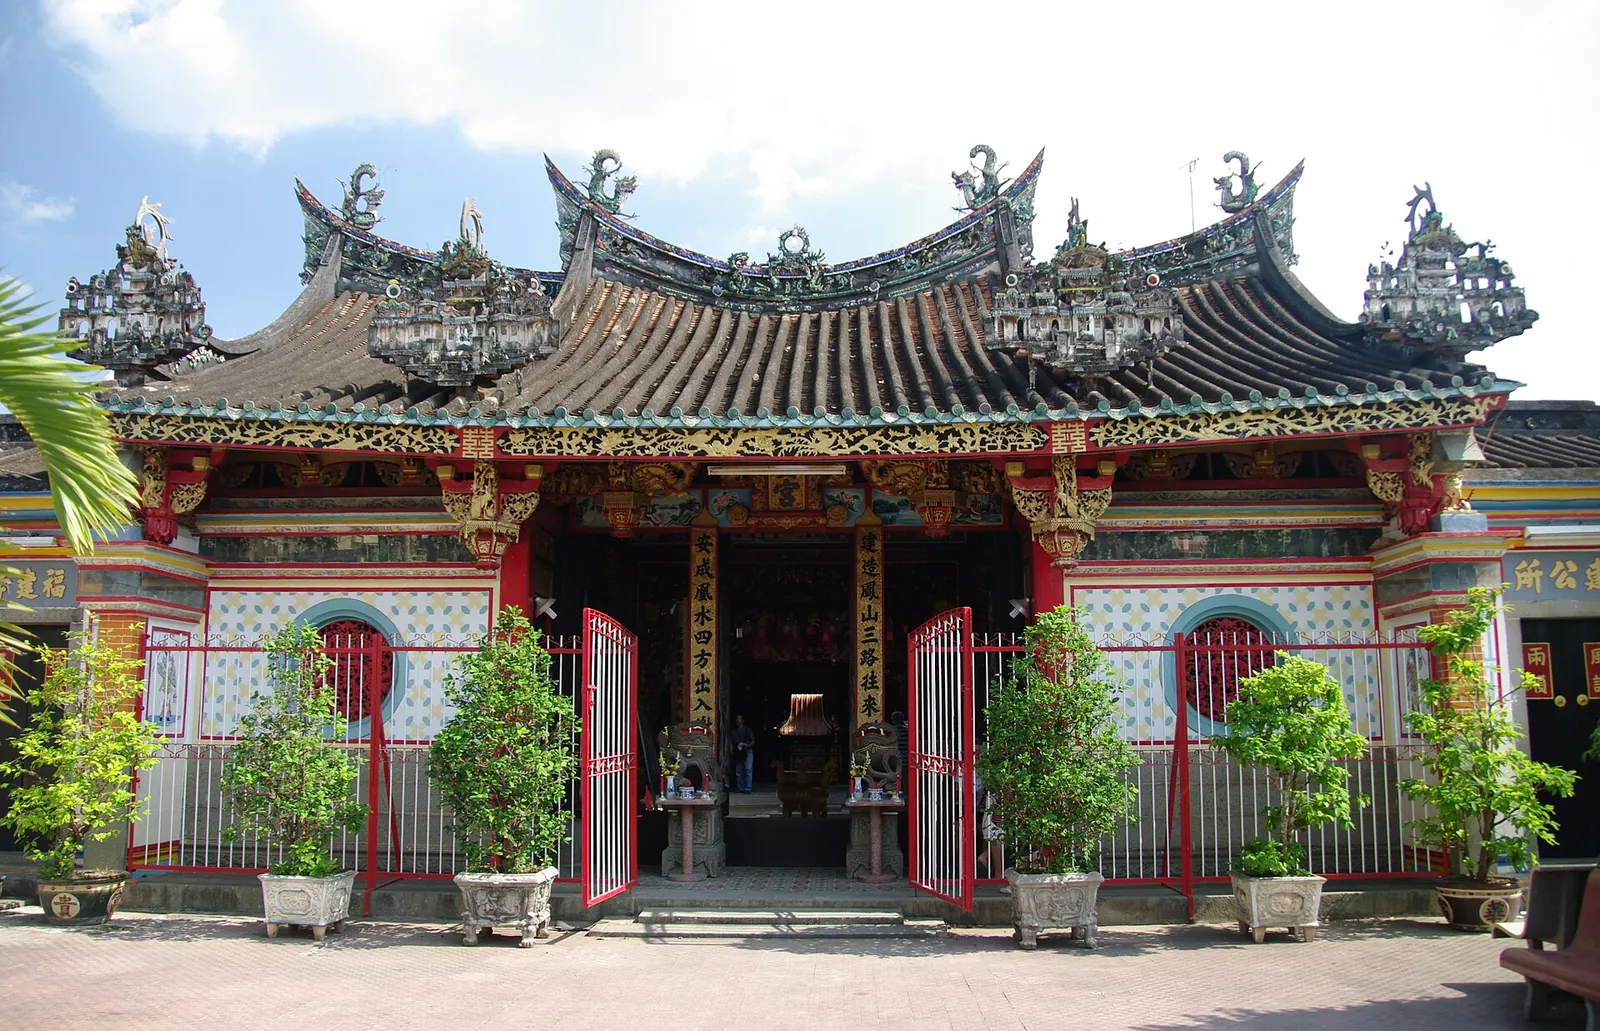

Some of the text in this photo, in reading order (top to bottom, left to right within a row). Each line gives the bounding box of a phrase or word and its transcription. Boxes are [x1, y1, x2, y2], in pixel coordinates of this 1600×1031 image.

[860, 533, 880, 725] 建造鳳山三路往來
[53, 895, 78, 917] 貴
